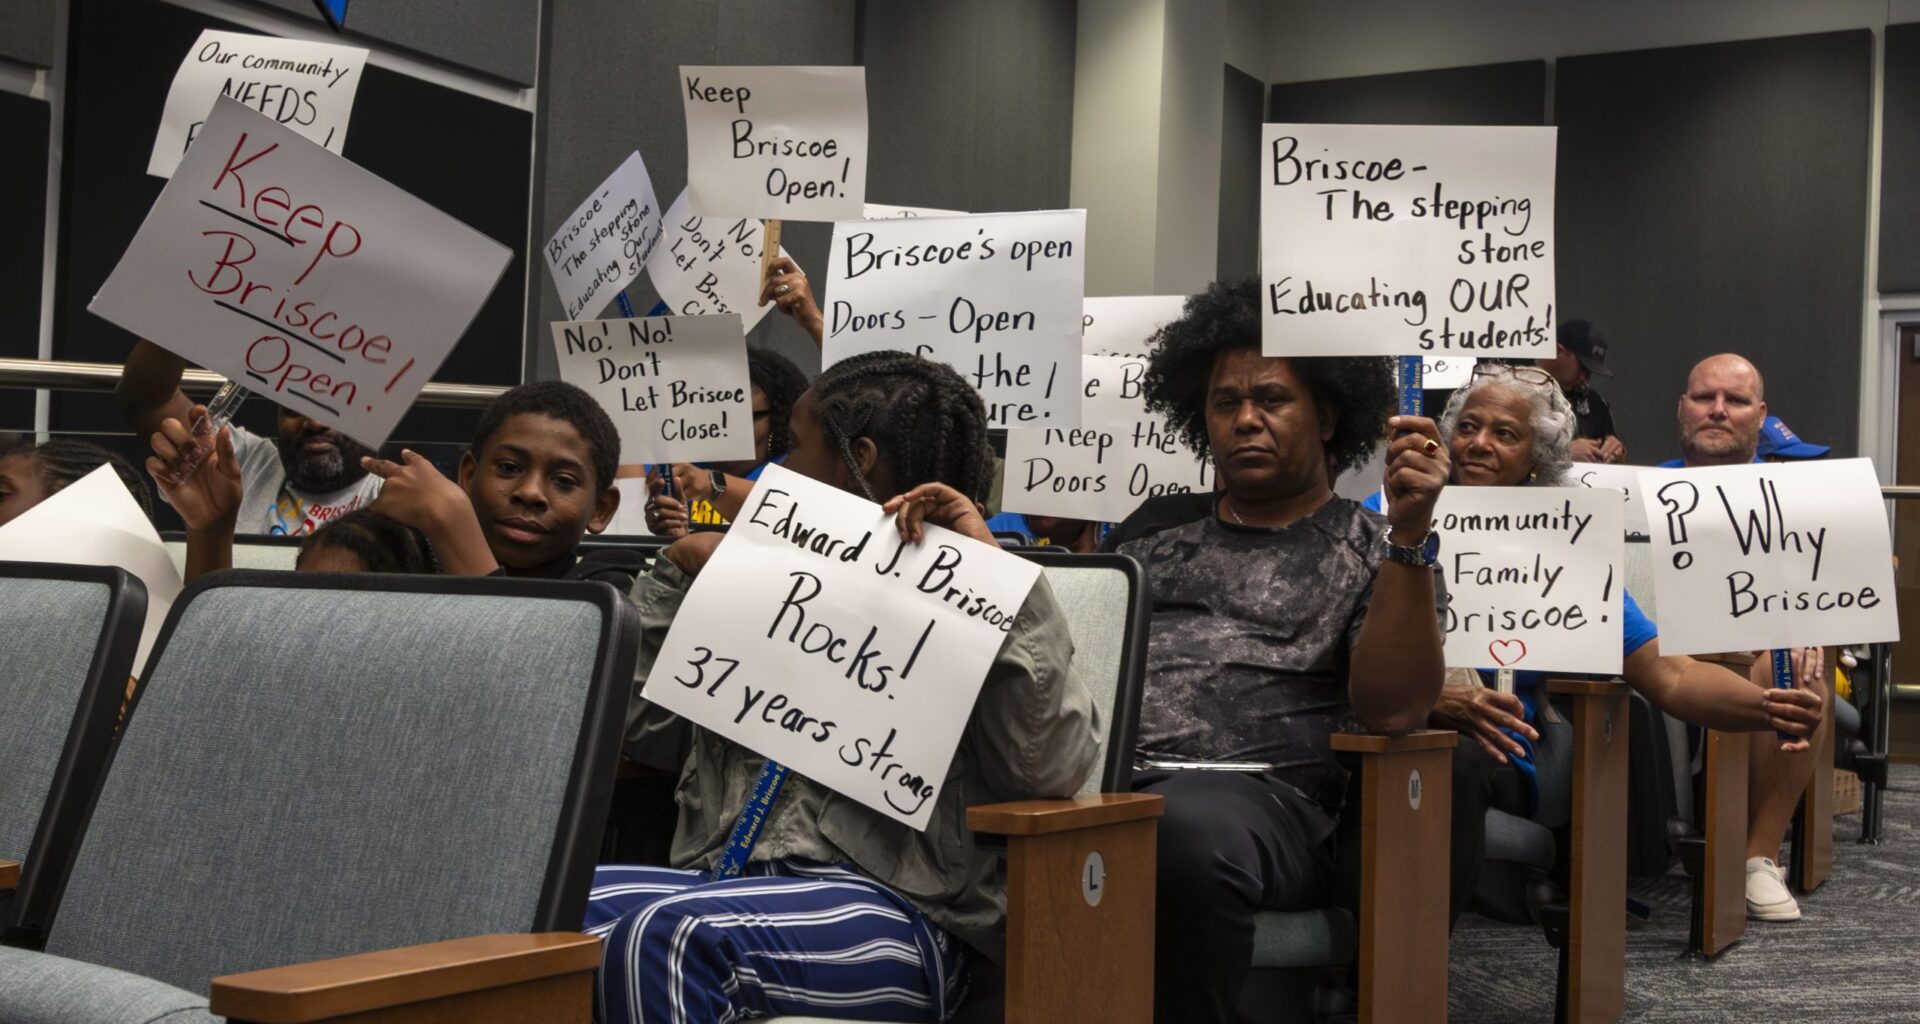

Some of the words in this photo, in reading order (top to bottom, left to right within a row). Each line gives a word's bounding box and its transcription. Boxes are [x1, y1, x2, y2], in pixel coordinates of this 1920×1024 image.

[199, 41, 238, 64] Our
[242, 53, 349, 87] community
[686, 77, 751, 113] Keep
[731, 119, 837, 159] Briscoe
[766, 157, 850, 203] Open!
[212, 133, 362, 285] Keep
[1316, 189, 1394, 221] The
[1411, 182, 1531, 236] stepping
[561, 251, 588, 277] The
[589, 198, 638, 252] stepping
[680, 216, 726, 262] Don't
[844, 229, 996, 280] Briscoe's
[1010, 240, 1073, 272] open
[1458, 233, 1545, 264] stone
[568, 259, 621, 321] Educating
[624, 226, 649, 259] Our
[670, 237, 697, 272] Let
[696, 271, 732, 314] Bris
[188, 231, 392, 364] Briscoe
[830, 301, 905, 338] Doors
[949, 296, 1036, 343] Open
[1269, 276, 1427, 326] Educating
[1450, 273, 1530, 313] OUR
[564, 322, 612, 355] No!
[628, 317, 673, 347] No!
[1419, 303, 1552, 350] students!
[246, 336, 415, 412] Open!
[597, 351, 661, 384] Don't
[972, 352, 1031, 389] the
[622, 386, 660, 412] Let
[668, 380, 745, 408] Briscoe
[661, 411, 728, 441] Close!
[1131, 421, 1177, 454] the
[1023, 457, 1107, 493] Doors
[1431, 500, 1592, 545] ommunity
[1715, 477, 1826, 581] Why
[749, 489, 872, 563] Edward
[917, 545, 1013, 633] Briscoe
[1455, 552, 1563, 598] Family
[1727, 570, 1881, 618] Briscoe
[767, 571, 935, 700] Rocks!
[674, 647, 740, 698] 37
[734, 685, 838, 742] years
[839, 728, 934, 815] strong
[740, 815, 761, 849] Edward
[761, 773, 780, 805] Briscoe
[1089, 864, 1098, 890] L
